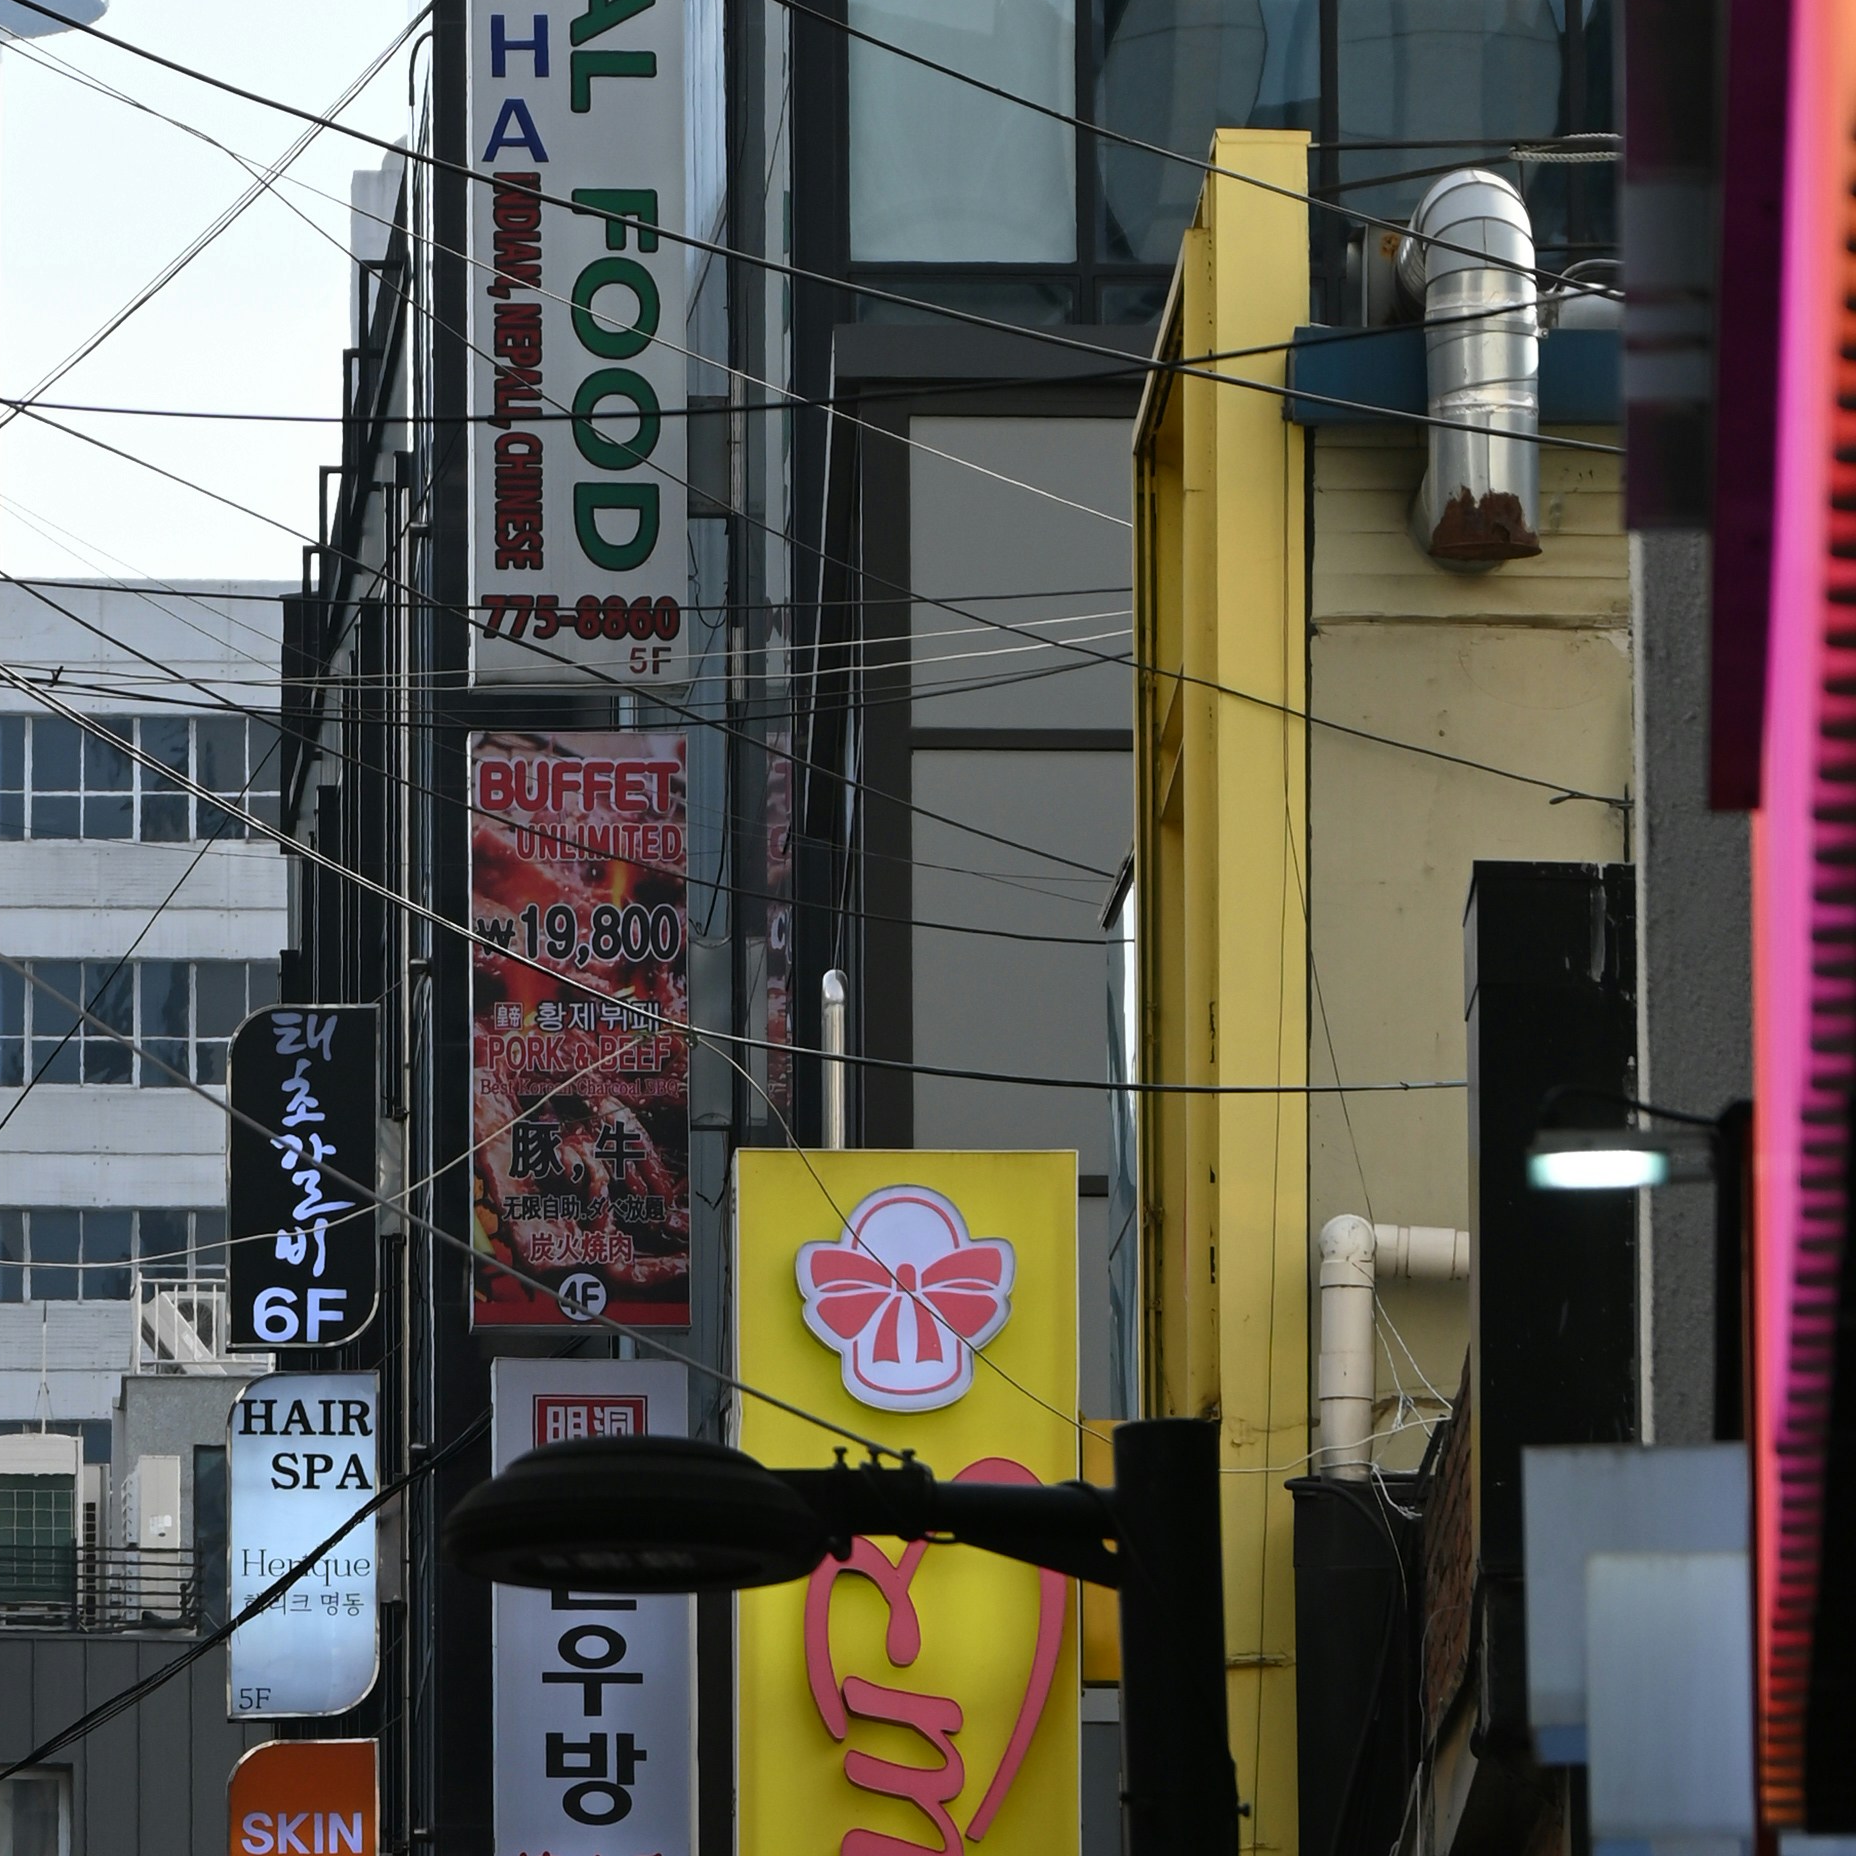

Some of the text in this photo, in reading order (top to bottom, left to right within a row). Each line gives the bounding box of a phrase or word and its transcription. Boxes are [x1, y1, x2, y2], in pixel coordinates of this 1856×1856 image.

[571, 187, 661, 572] FOOD
[494, 431, 544, 572] CHINESE
[483, 595, 681, 642] 775-8860
[629, 646, 672, 675] 5F
[477, 761, 680, 812] BUFFET
[516, 824, 684, 862] UNLIMITED
[536, 1001, 661, 1032] 황제뷔페
[488, 1035, 672, 1073] PORK & BEEF
[481, 1079, 514, 1096] Best
[576, 1079, 642, 1096] Charcoal
[253, 1286, 348, 1343] 6F
[560, 1280, 601, 1315] 4F
[238, 1399, 373, 1437] HAIR
[271, 1452, 373, 1490] SPA
[321, 1592, 365, 1617] 명동
[238, 1688, 271, 1710] 5F
[241, 1811, 363, 1855] SKIN
